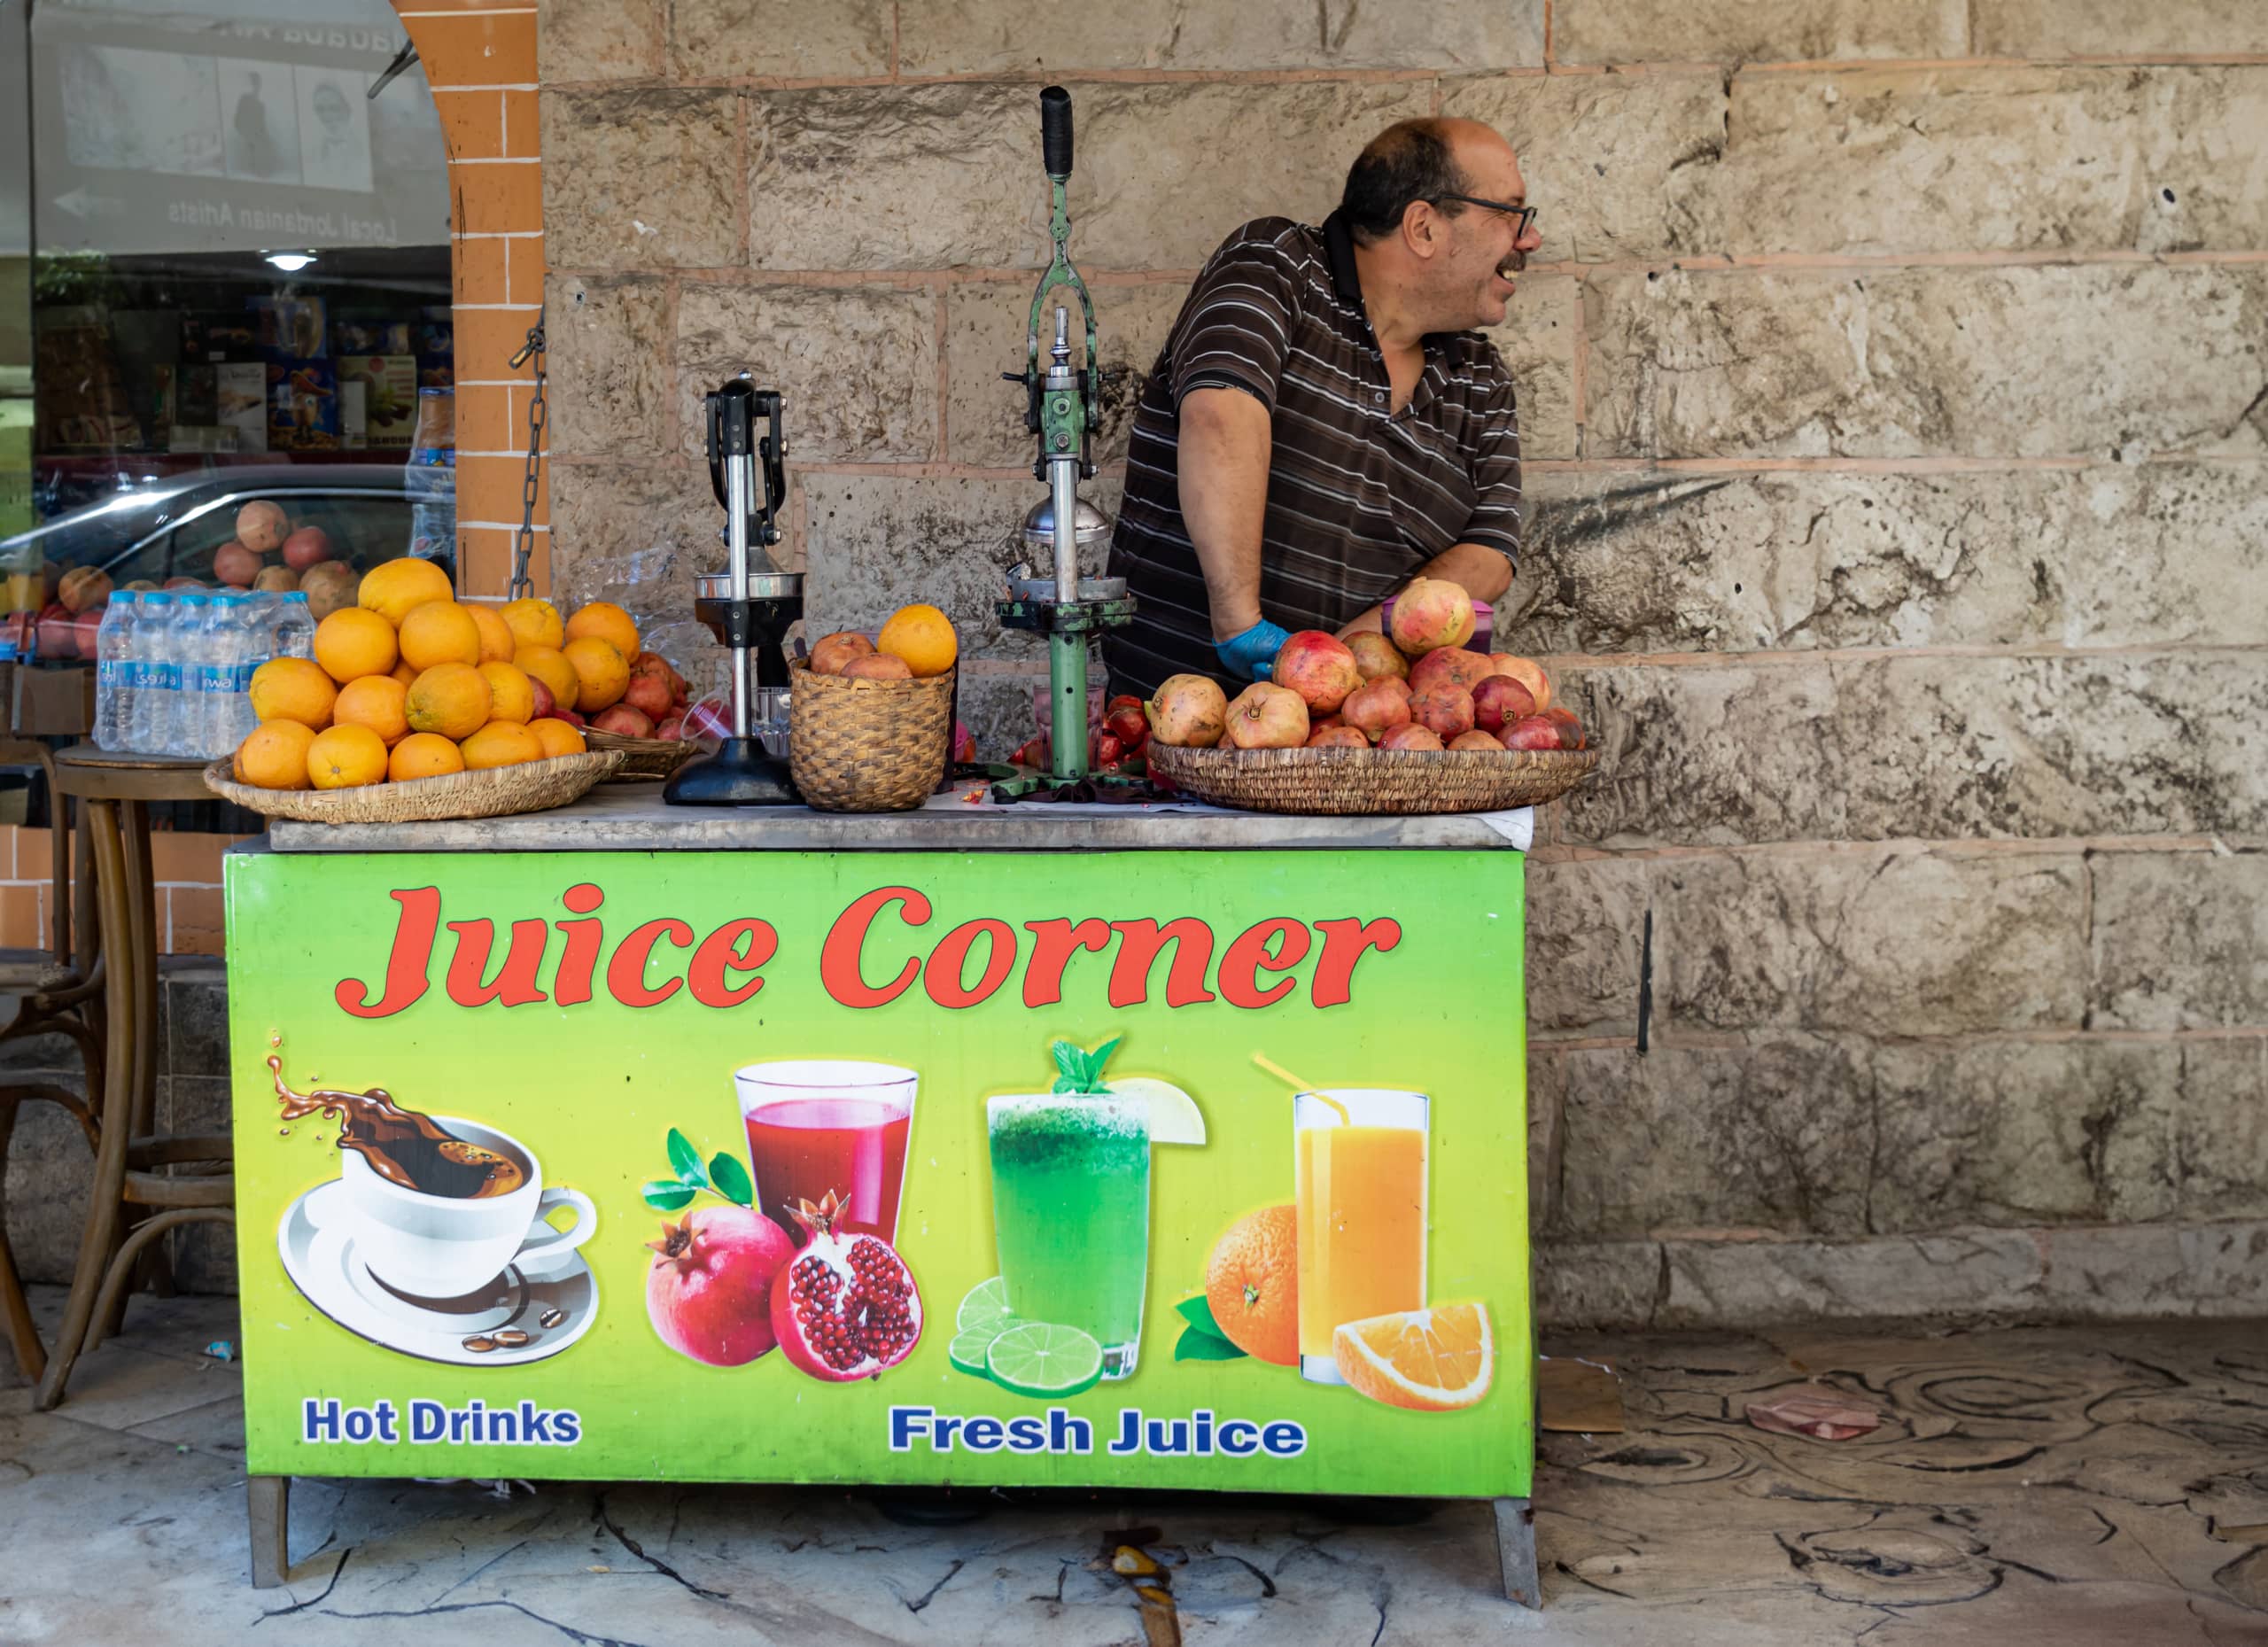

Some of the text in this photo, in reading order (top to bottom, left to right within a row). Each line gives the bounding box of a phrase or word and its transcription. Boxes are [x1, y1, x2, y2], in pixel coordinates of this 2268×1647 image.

[334, 882, 1402, 1019] Juice Corner
[305, 1400, 580, 1443] Hot Drinks
[890, 1407, 1305, 1455] Fresh Juice
